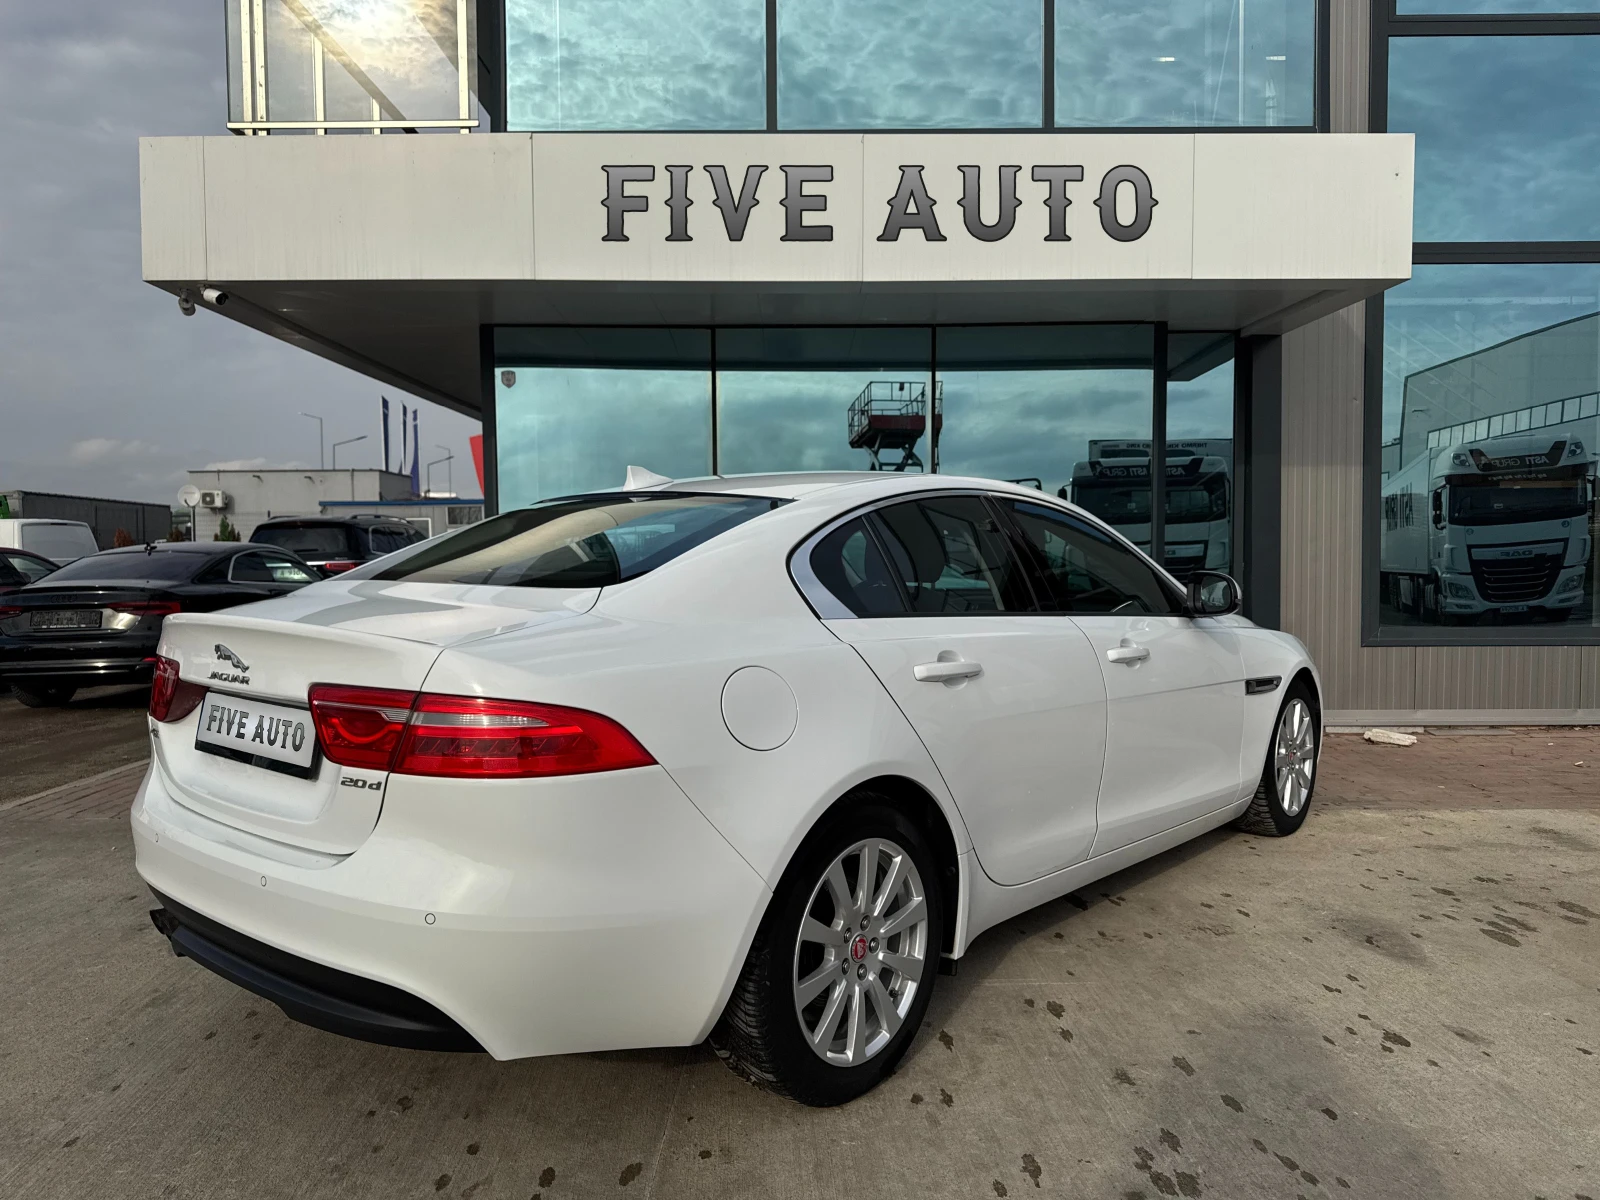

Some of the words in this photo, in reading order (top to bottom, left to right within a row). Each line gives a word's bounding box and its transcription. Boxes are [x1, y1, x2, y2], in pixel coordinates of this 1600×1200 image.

[601, 164, 834, 242] FIVE
[876, 164, 1159, 242] AUTO
[208, 671, 251, 685] JAGUAR
[206, 704, 250, 740] FIVE
[250, 714, 306, 752] AUTO
[340, 776, 383, 791] 20d
